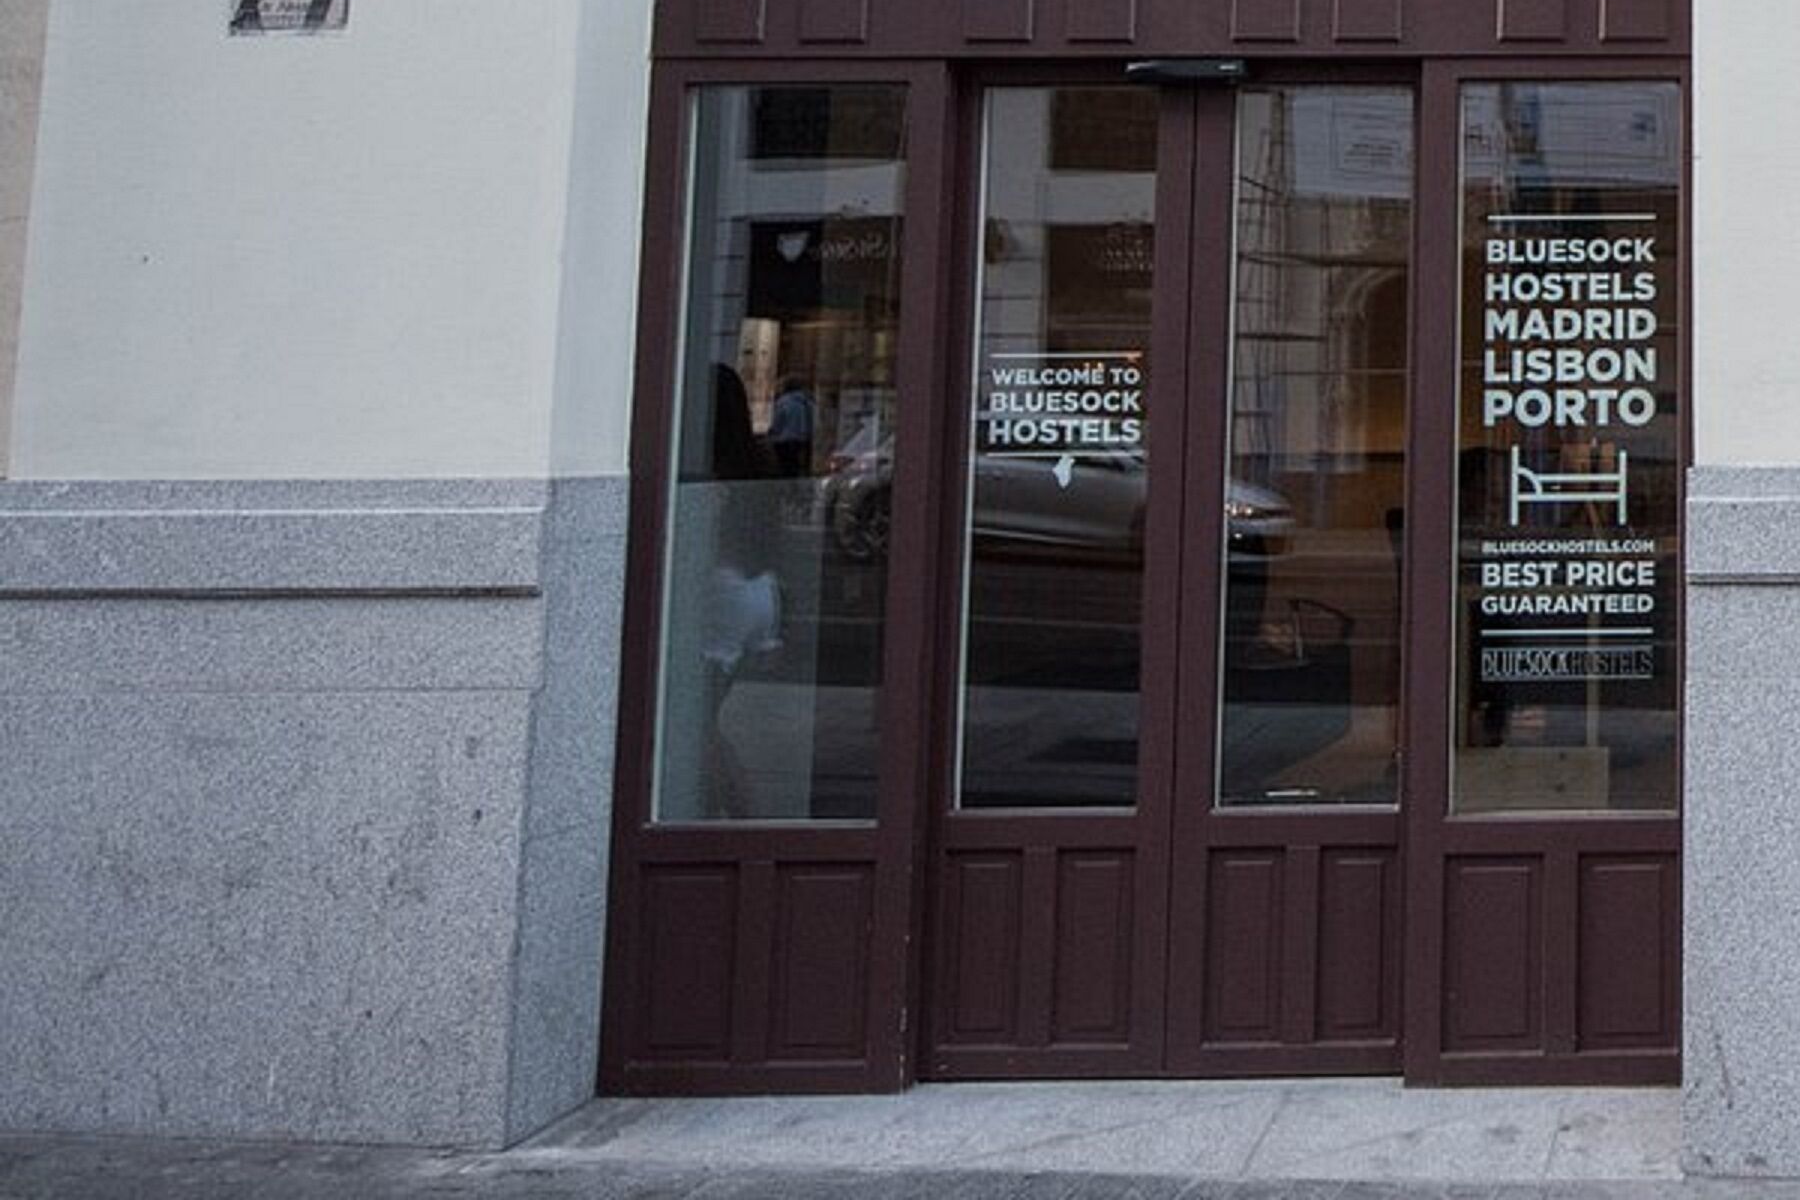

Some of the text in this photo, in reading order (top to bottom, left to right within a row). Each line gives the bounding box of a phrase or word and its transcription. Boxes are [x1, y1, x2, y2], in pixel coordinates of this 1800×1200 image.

[1486, 237, 1656, 264] BLUESOCK
[1486, 272, 1657, 302] HOSTELS
[1484, 308, 1657, 342] MADRID
[991, 367, 1141, 386] WELCOME TO
[1483, 347, 1657, 384] LISBON
[989, 390, 1141, 414] BLUESOCK
[1483, 388, 1656, 427] PORTO
[988, 417, 1142, 445] HOSTELS
[1481, 539, 1655, 554] BLUESOCKHOSTELS.COM
[1482, 560, 1656, 588] BEST PRICE
[1481, 592, 1655, 615] GUARANTEED
